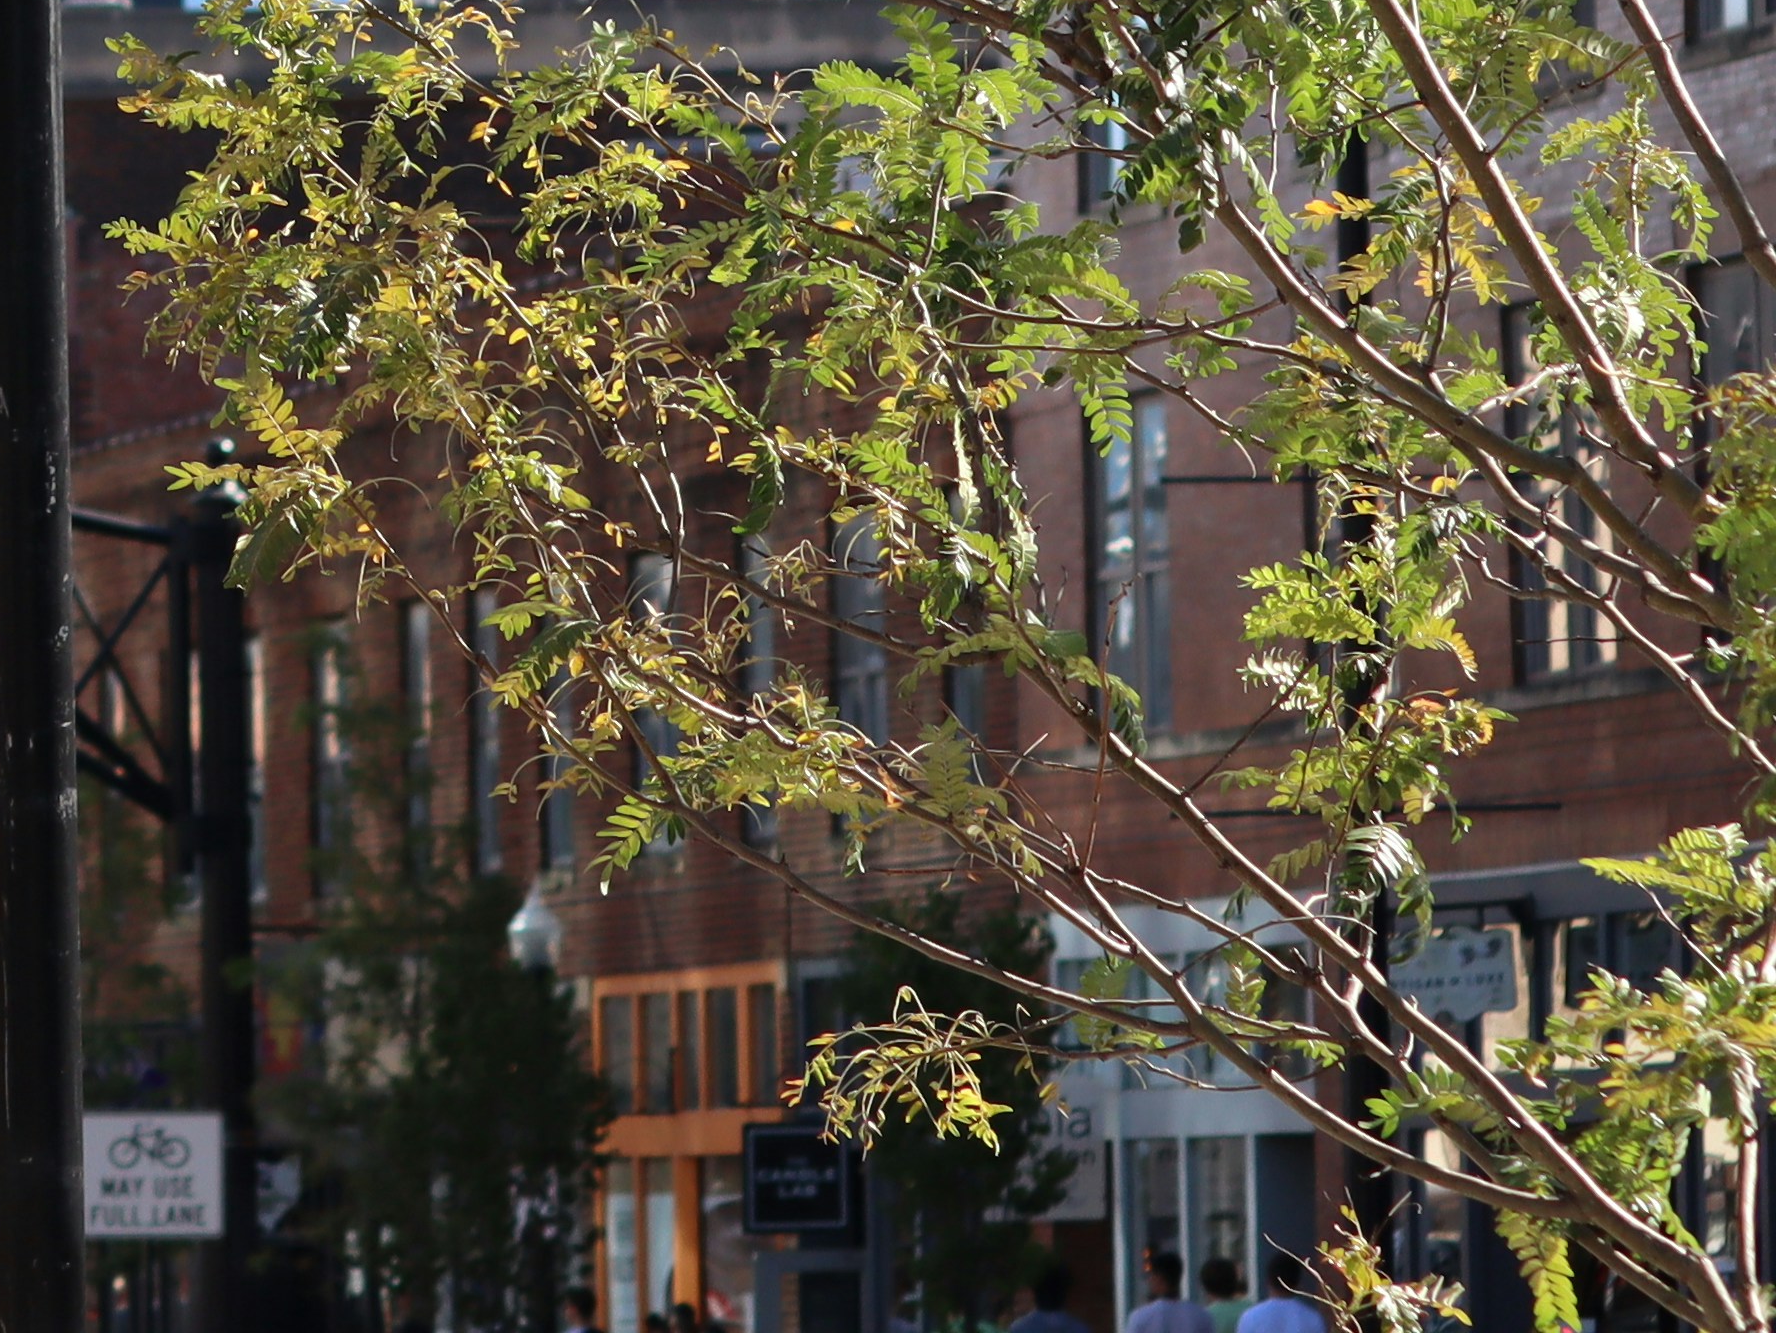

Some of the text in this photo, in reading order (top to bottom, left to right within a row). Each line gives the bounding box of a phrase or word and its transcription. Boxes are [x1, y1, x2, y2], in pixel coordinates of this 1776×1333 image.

[101, 1175, 194, 1198] MAY USE
[90, 1204, 207, 1228] FULL LANE
